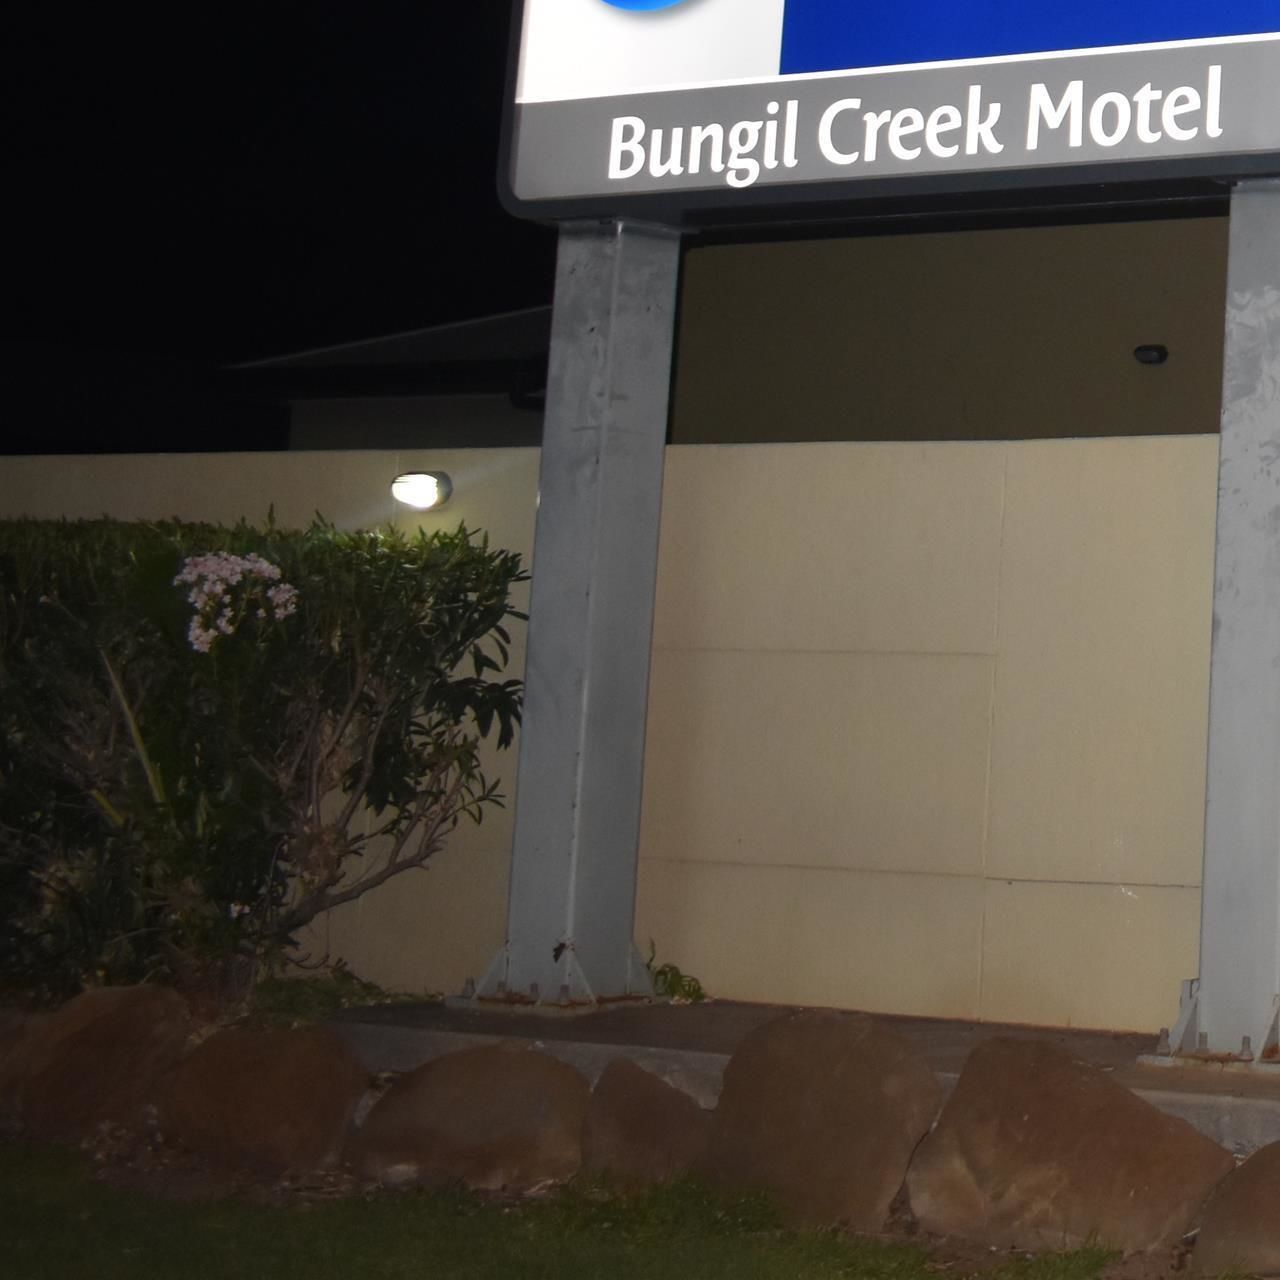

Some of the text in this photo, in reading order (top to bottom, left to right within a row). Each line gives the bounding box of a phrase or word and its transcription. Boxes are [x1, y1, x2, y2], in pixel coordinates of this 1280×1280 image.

[607, 66, 1224, 188] Bungil Creek Motel
